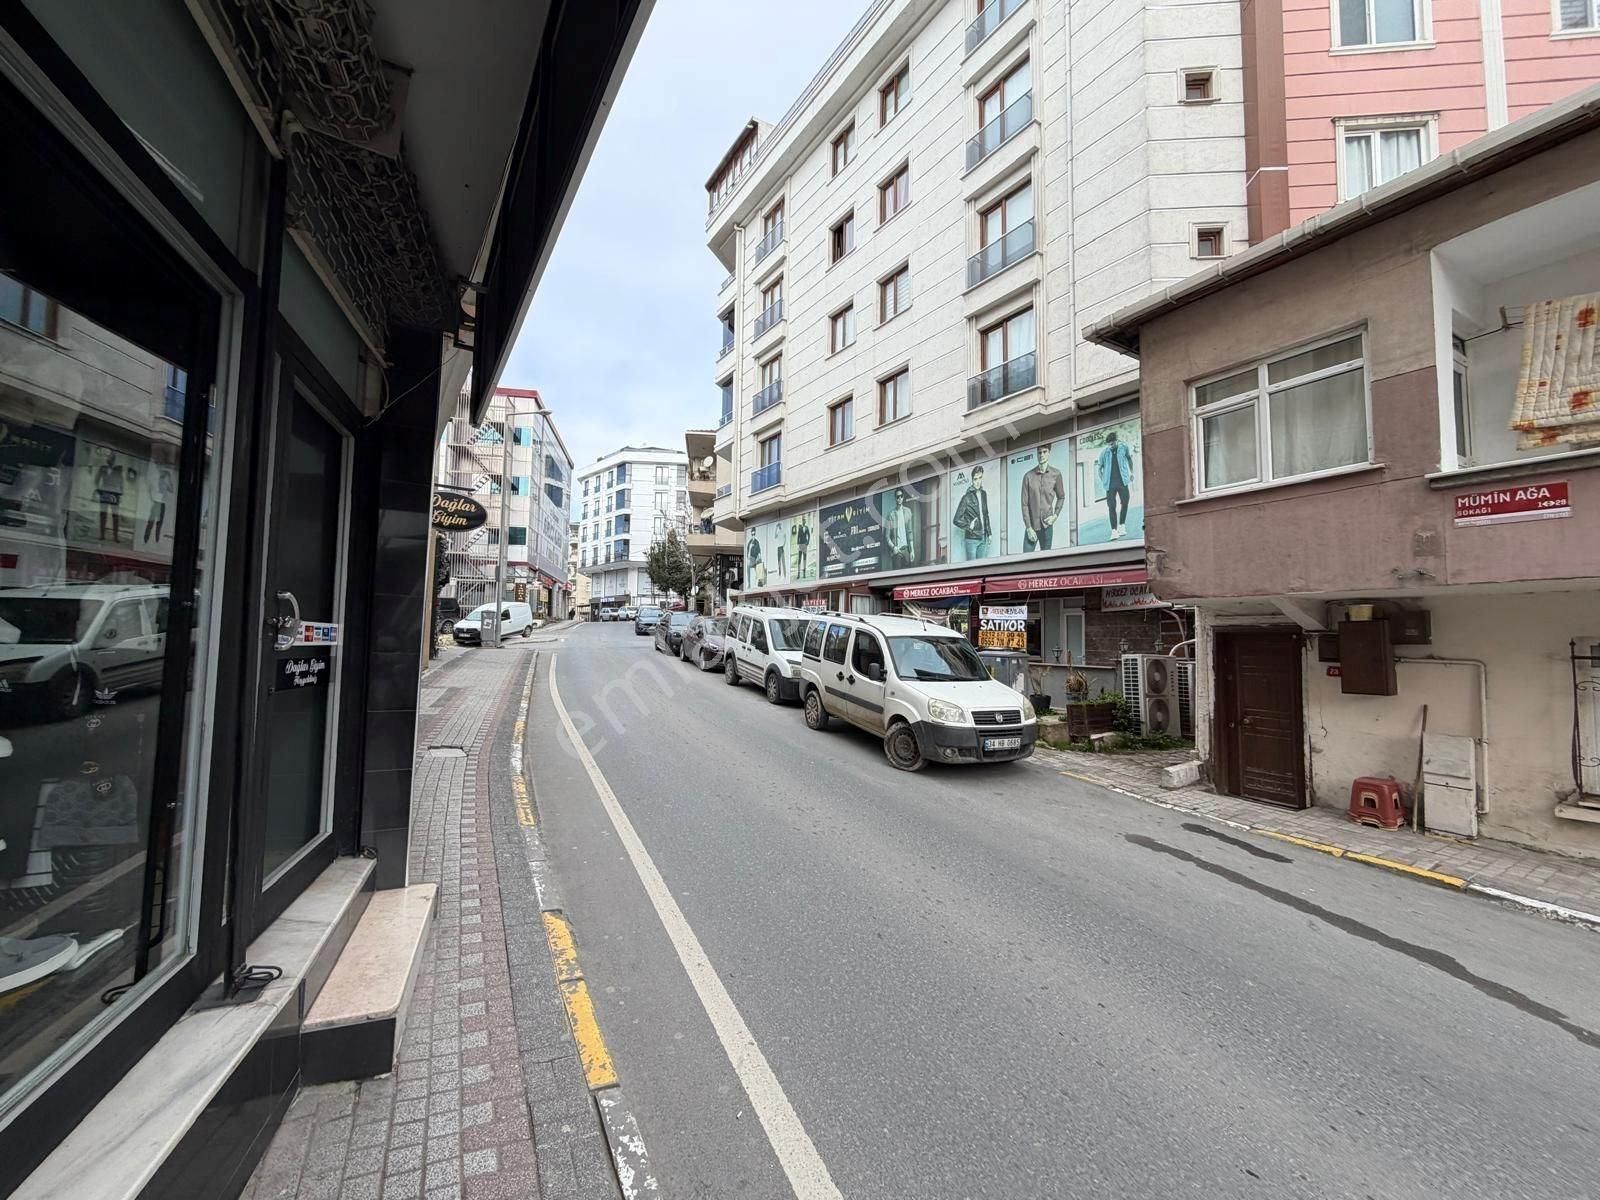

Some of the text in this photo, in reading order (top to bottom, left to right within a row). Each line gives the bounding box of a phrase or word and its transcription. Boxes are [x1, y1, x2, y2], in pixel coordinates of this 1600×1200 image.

[1457, 486, 1551, 507] MÜMİN AĞA
[432, 510, 467, 526] Giyim
[1028, 578, 1058, 589] MERKEZ
[909, 588, 930, 597] MERKEZ
[980, 619, 1026, 632] SATIYOR
